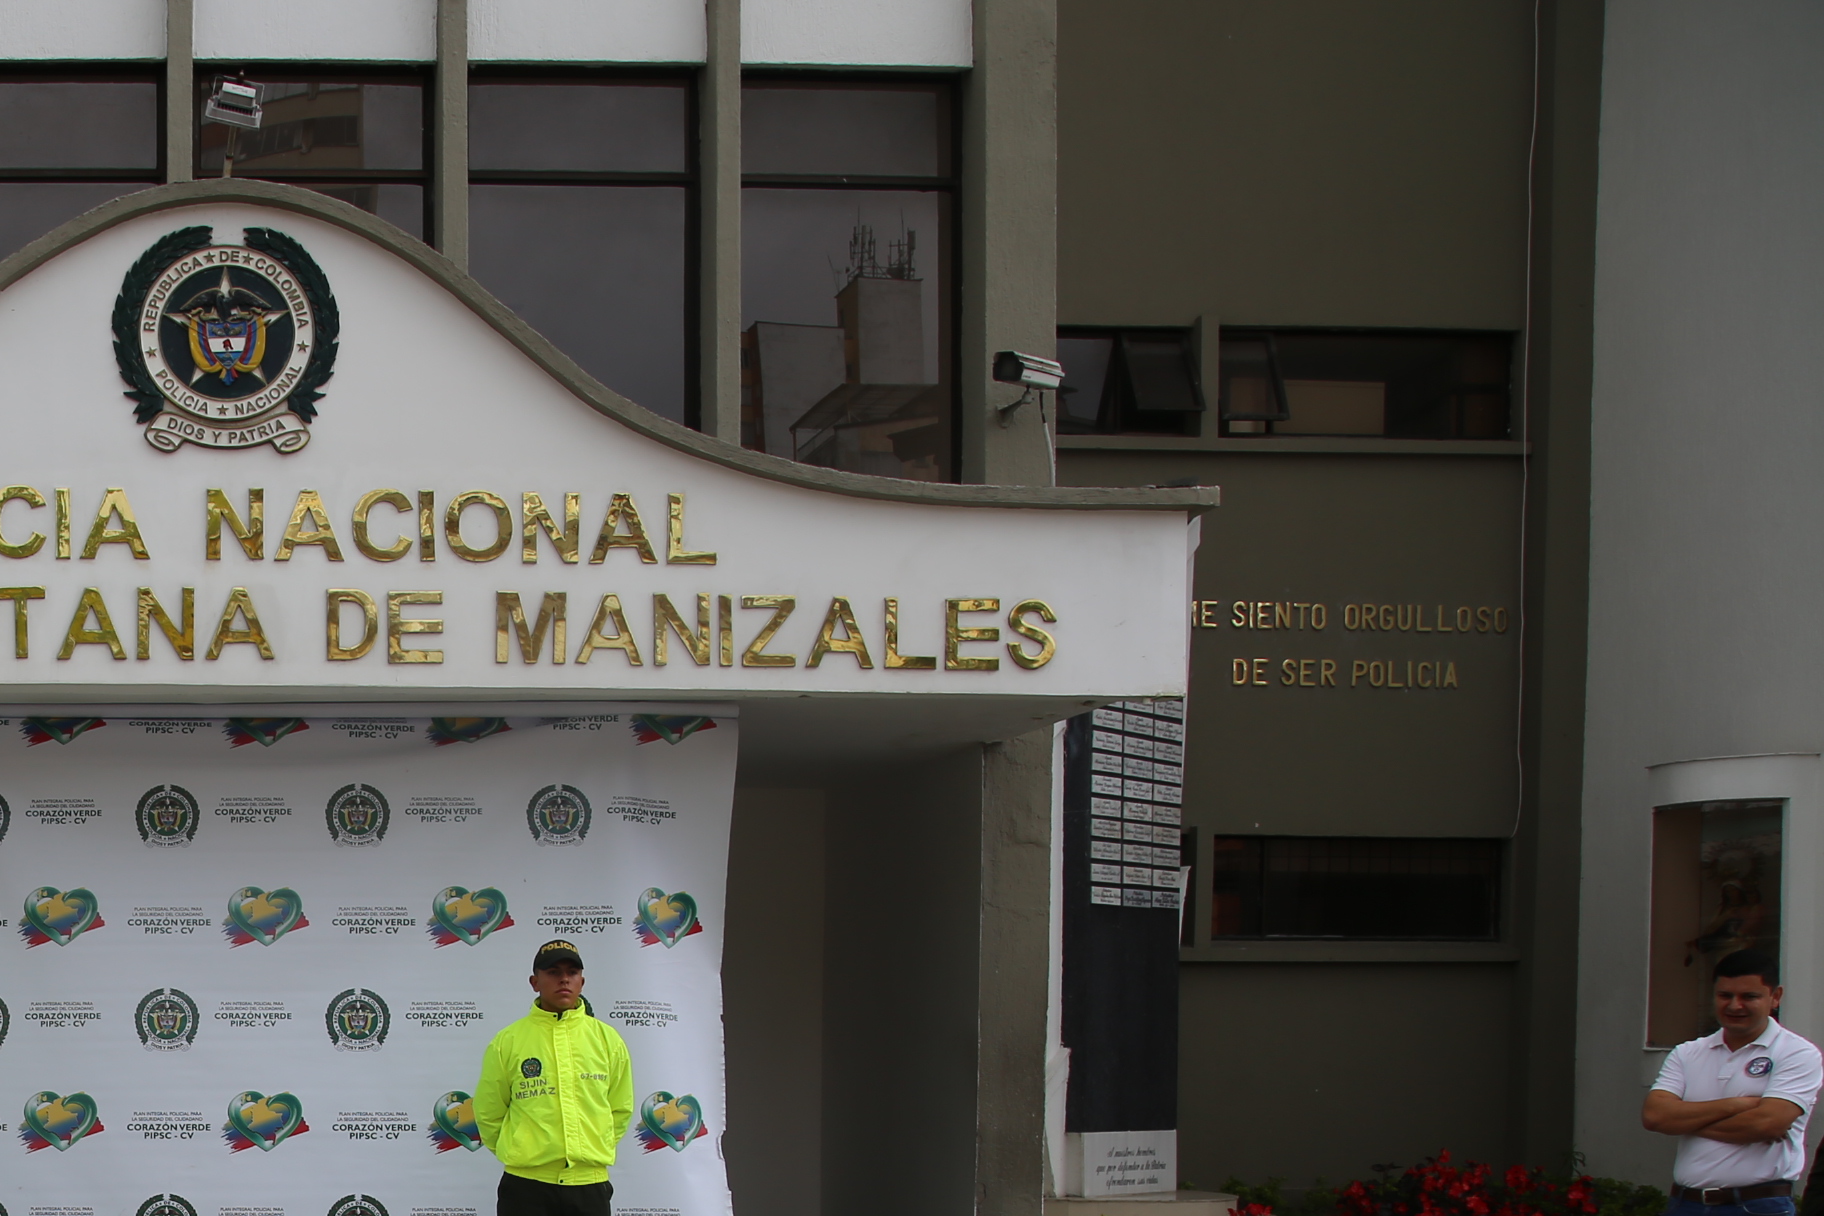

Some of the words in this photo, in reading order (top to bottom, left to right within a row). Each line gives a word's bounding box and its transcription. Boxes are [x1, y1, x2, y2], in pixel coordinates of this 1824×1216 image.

[143, 256, 204, 332] REPUBLICA
[219, 250, 241, 263] DE
[255, 257, 310, 330] COLOMBIA
[155, 368, 209, 415] POLICIA
[234, 364, 302, 416] NACIONAL
[167, 417, 206, 440] DIOS
[212, 431, 222, 444] Y
[228, 418, 287, 444] PATRIA
[205, 487, 718, 566] NACIONAL
[1231, 600, 1327, 630] SIENTO
[1344, 603, 1508, 633] ORGULLOSO
[325, 587, 444, 665] DE
[495, 589, 1057, 671] MANIZALES
[1232, 658, 1269, 686] DE
[1280, 659, 1337, 687] SER
[1351, 661, 1458, 688] POLICIA
[25, 808, 72, 818] CORAZÓN
[214, 807, 262, 816] CORAZÓN
[41, 817, 66, 825] PIPSC
[73, 817, 87, 825] CV
[230, 815, 256, 824] PIPSC
[263, 815, 277, 824] CV
[331, 917, 383, 927] CORAZÓN
[383, 918, 416, 926] VERDE
[536, 916, 589, 926] CORAZÓN
[589, 917, 622, 925] VERDE
[349, 926, 377, 935] PIPSC
[384, 926, 399, 935] CV
[554, 925, 583, 934] PIPSC
[590, 925, 606, 934] CV
[520, 1079, 548, 1090] SIJIN
[515, 1087, 556, 1100] MEMAZ
